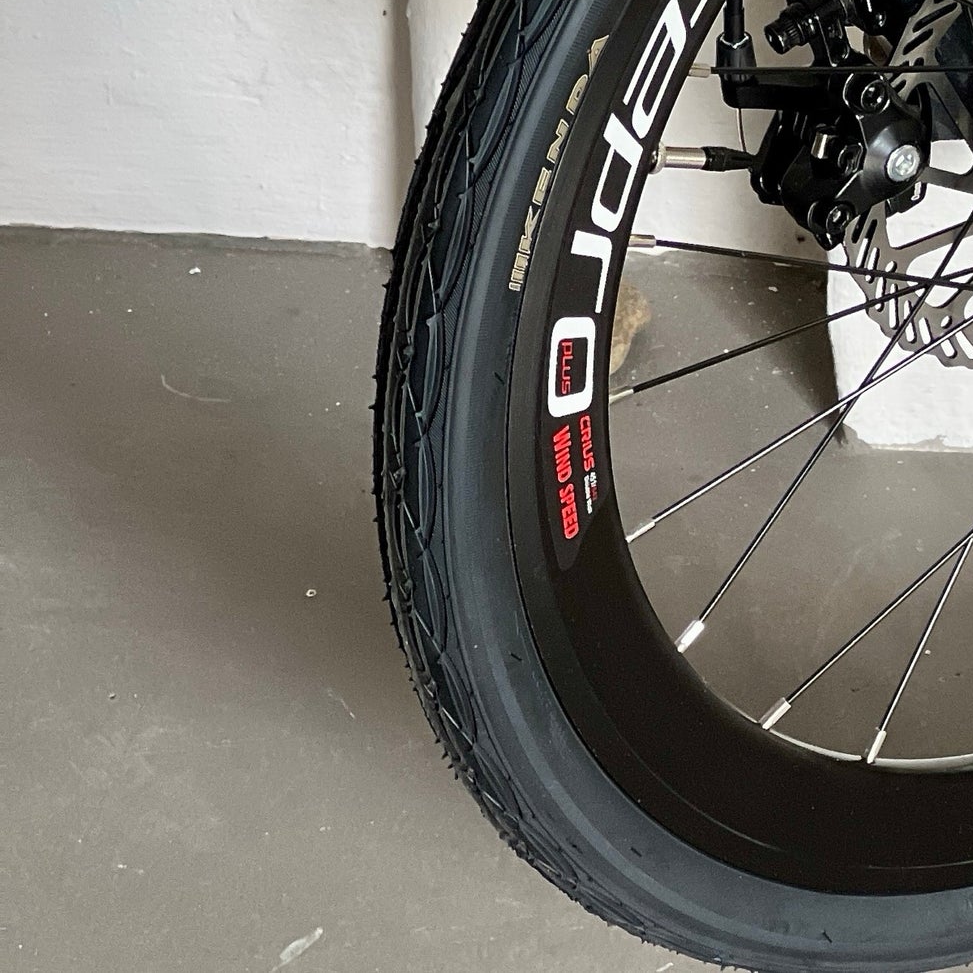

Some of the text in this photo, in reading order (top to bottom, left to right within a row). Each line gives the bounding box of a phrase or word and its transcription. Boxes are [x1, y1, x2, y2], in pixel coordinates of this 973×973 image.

[519, 35, 609, 254] KENDA
[553, 424, 580, 540] WIND SPEED
[579, 415, 595, 472] CRIUS
